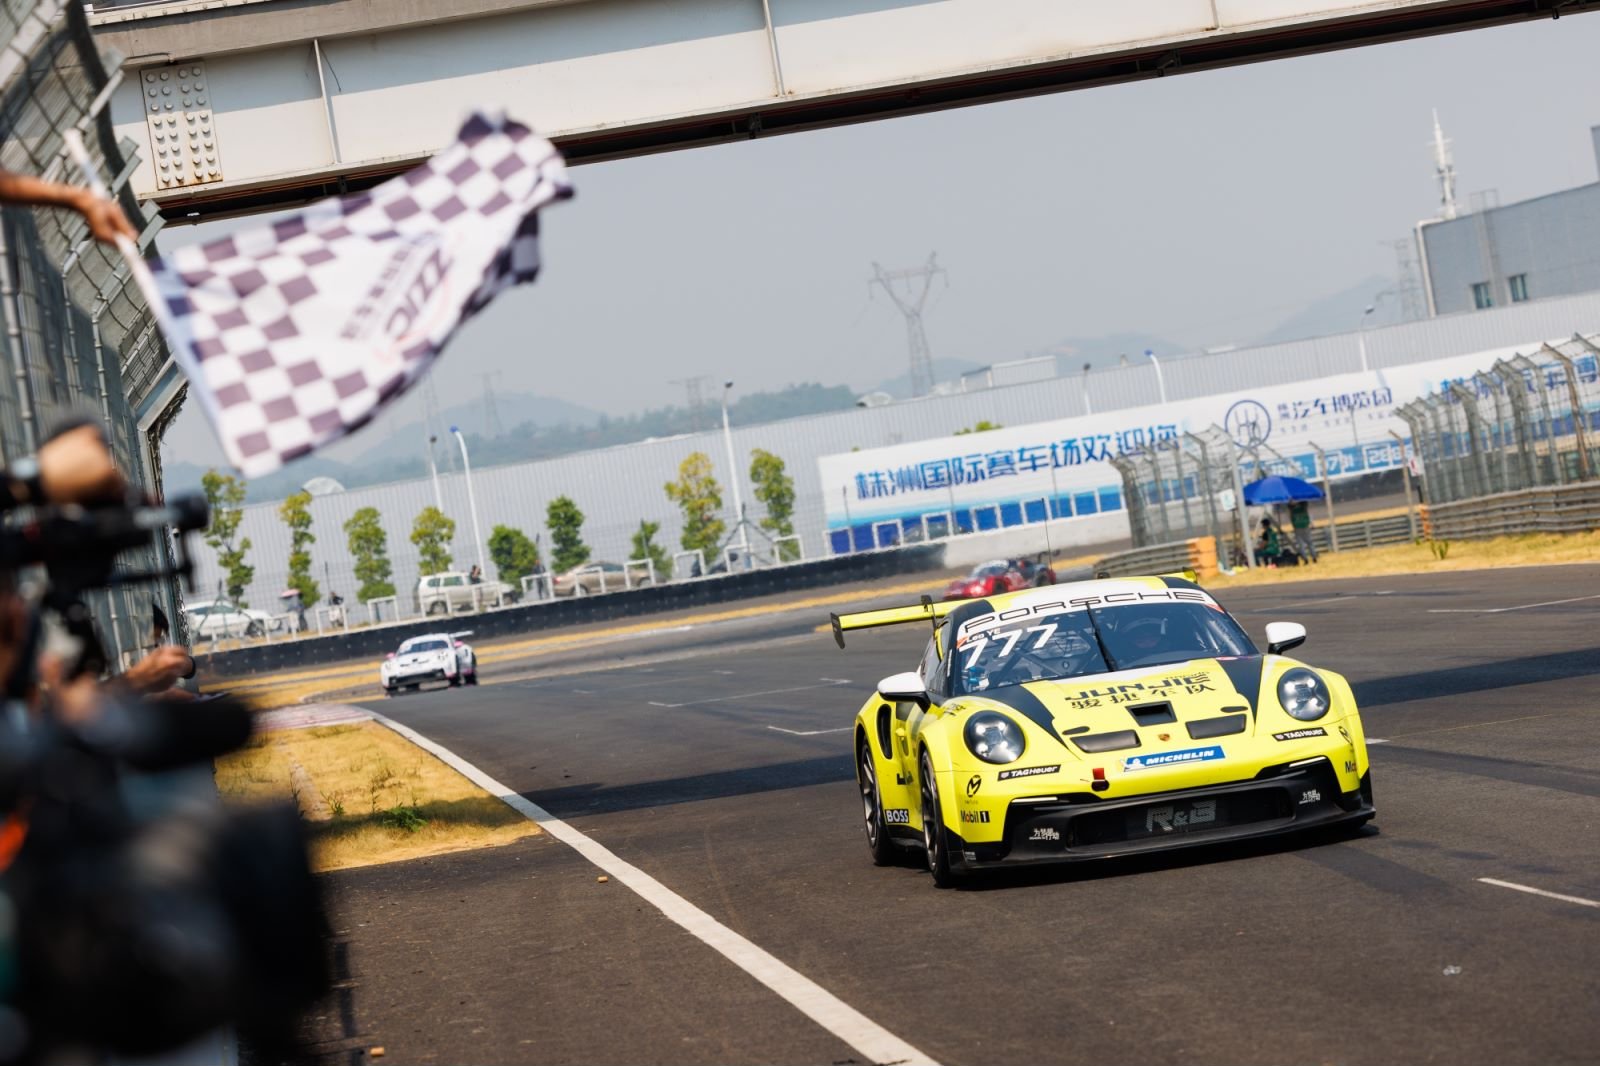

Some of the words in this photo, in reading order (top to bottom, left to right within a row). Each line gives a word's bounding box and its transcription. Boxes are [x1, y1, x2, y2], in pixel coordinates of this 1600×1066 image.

[856, 424, 1180, 500] 株洲国际赛车场欢迎您
[964, 591, 1206, 633] PORSCHE
[958, 622, 1058, 670] 777
[1145, 750, 1215, 765] MICHELIN
[886, 809, 909, 824] BOSS
[961, 810, 979, 824] Mobil
